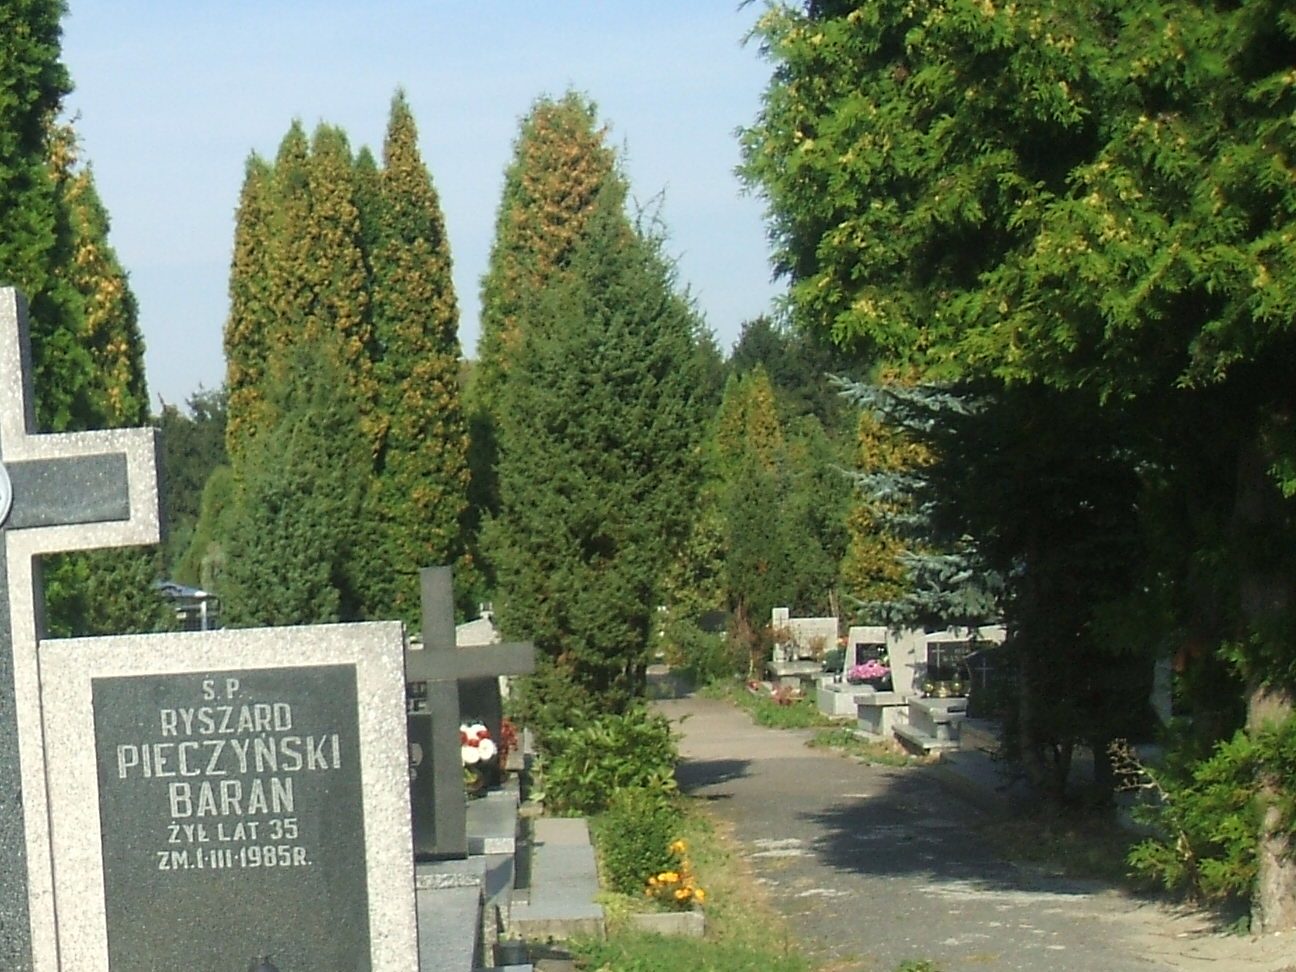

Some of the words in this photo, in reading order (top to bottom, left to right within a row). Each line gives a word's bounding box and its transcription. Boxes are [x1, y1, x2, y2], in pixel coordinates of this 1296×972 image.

[160, 703, 292, 737] RYSZARD
[117, 733, 341, 779] PIECZYŃSKI
[169, 777, 295, 818] BARAN
[168, 821, 210, 843] ŻYŁ
[217, 822, 259, 841] LAT
[269, 818, 298, 840] 35
